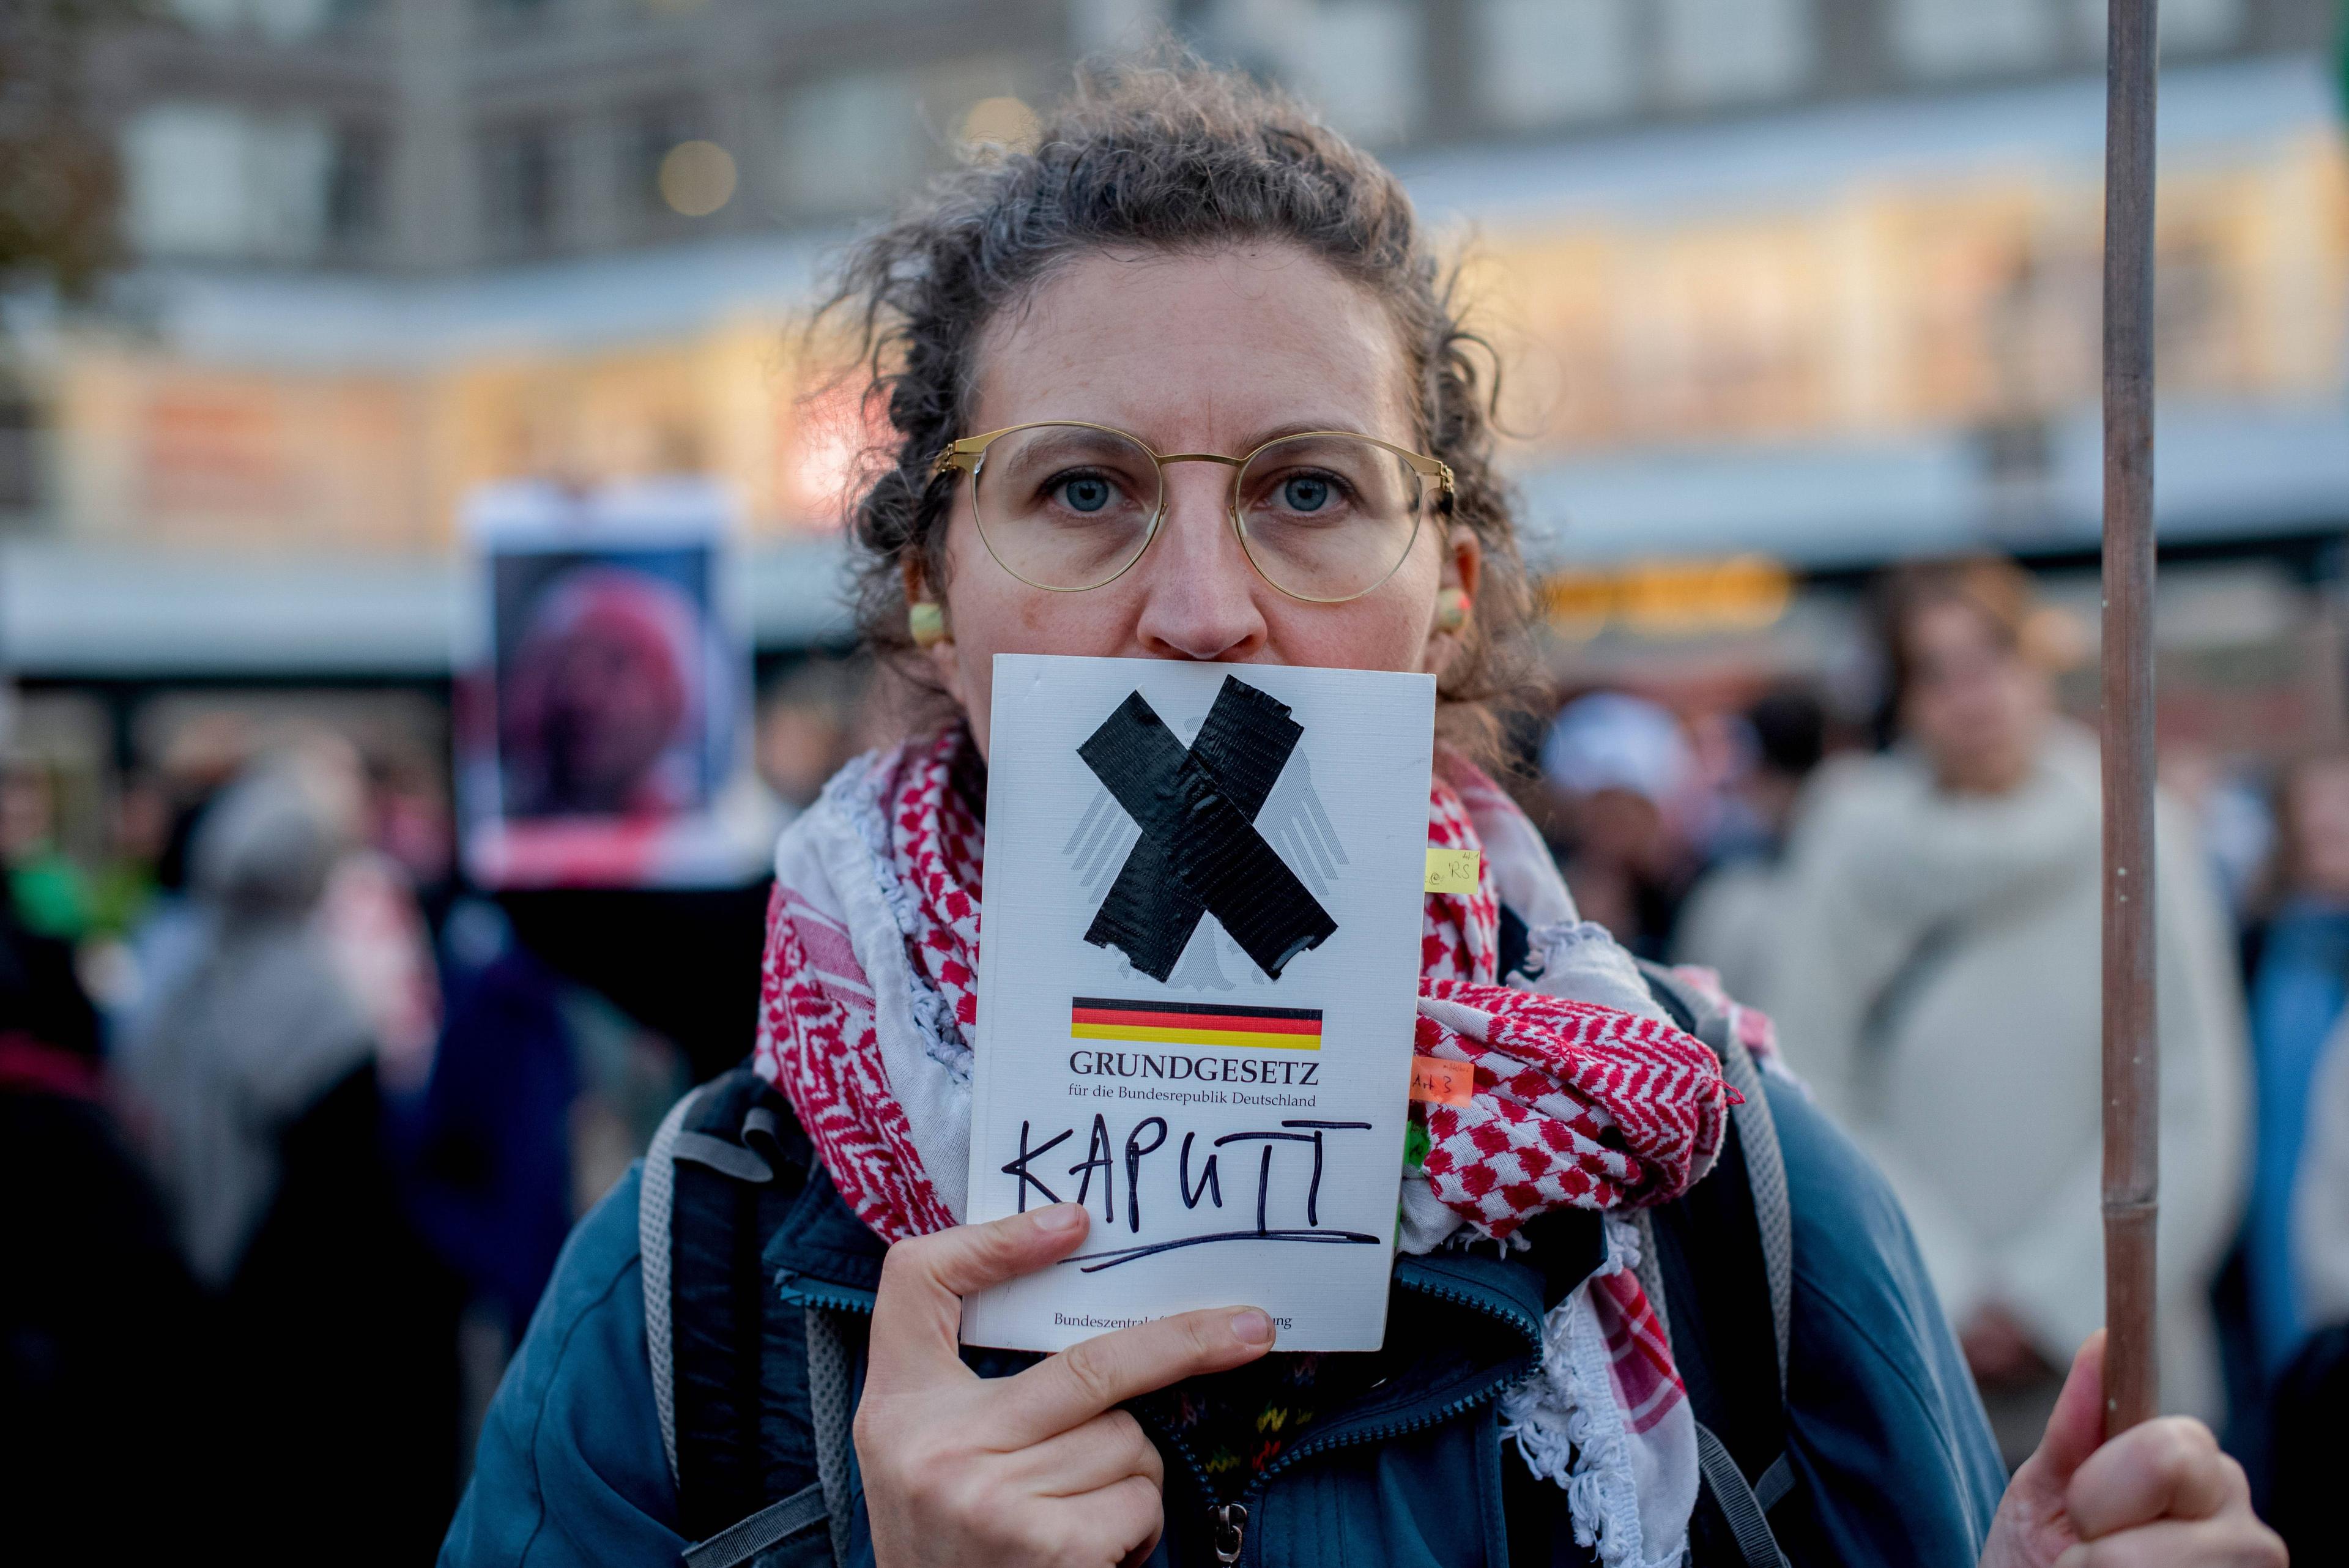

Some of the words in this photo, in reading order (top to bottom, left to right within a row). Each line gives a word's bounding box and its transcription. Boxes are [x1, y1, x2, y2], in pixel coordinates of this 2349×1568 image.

[1069, 1050, 1320, 1086] GRUNDGESETZ
[1412, 1073, 1434, 1090] Art
[1443, 1076, 1452, 1093] 3
[1068, 1083, 1089, 1096] für
[1093, 1084, 1114, 1098] die
[1118, 1086, 1228, 1105] Bundesrepublik
[1232, 1092, 1316, 1107] Deutschland
[1001, 1113, 1372, 1235] KAPUTT
